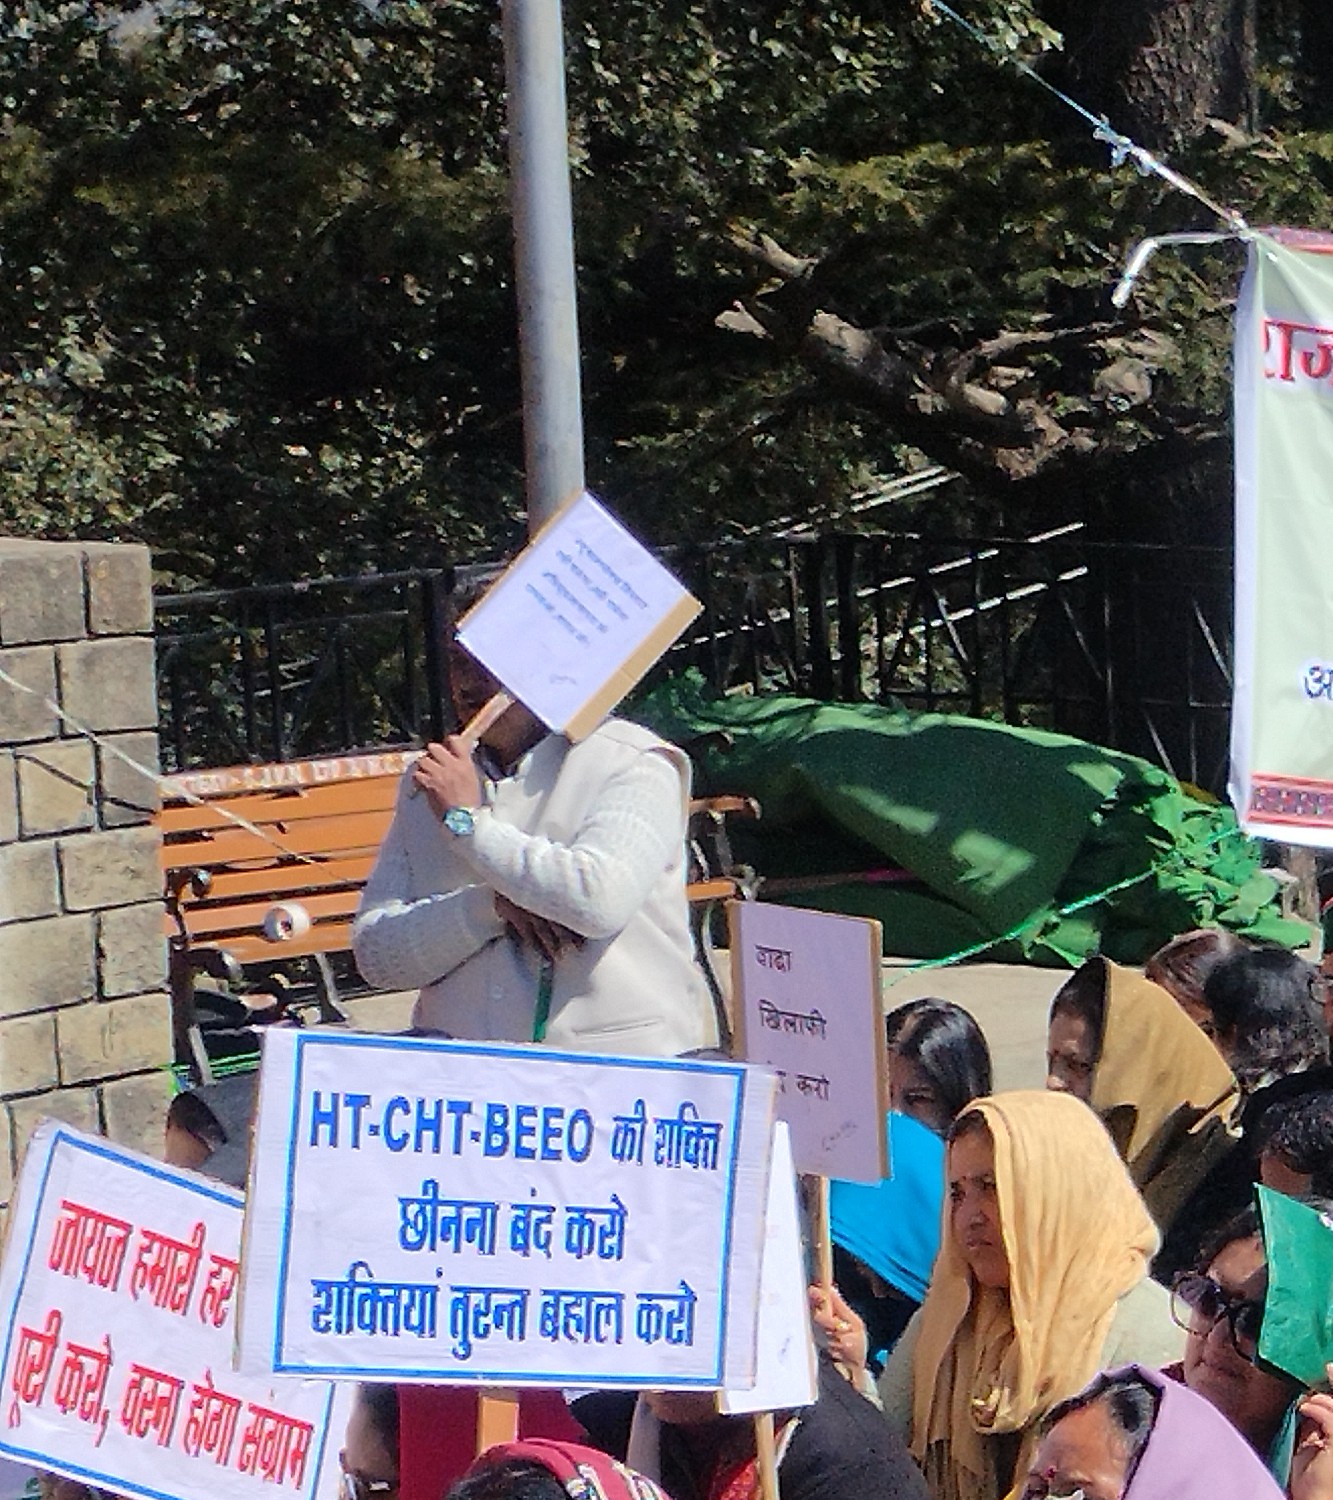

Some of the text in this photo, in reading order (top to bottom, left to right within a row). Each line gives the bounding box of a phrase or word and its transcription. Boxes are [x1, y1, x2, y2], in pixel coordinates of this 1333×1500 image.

[758, 998, 828, 1041] खिलाफी
[795, 1072, 830, 1102] करो
[308, 1090, 724, 1173] HT-CHT-BEEO की शक्ति
[48, 1198, 133, 1292] जायज
[129, 1220, 206, 1317] हमारी
[397, 1178, 628, 1263] छीनना बंद करो
[310, 1259, 697, 1361] शक्तियां तुरन्त बहाल करो
[8, 1309, 61, 1429] पूरी
[121, 1362, 185, 1448] वरना
[181, 1366, 243, 1466] होगा
